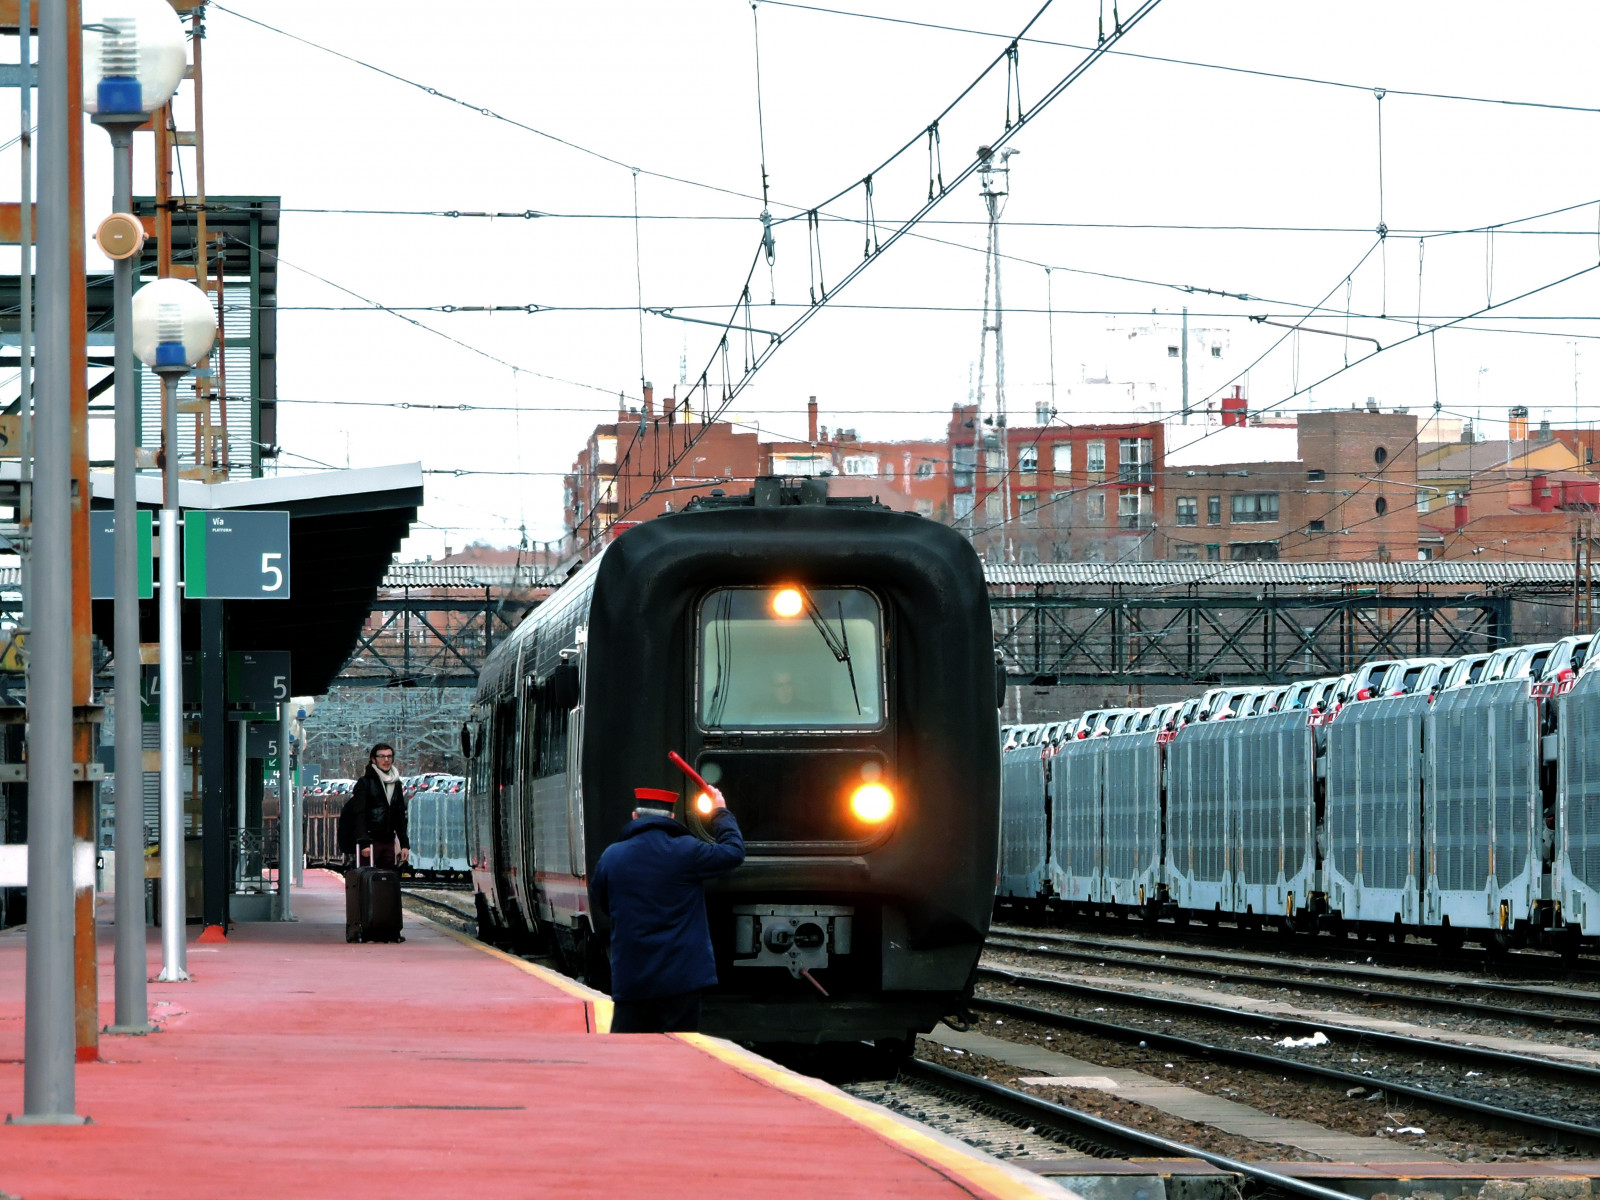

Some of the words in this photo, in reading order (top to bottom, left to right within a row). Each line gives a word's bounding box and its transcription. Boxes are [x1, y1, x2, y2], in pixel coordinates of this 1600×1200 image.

[261, 552, 283, 591] 5
[273, 675, 287, 699] 5
[268, 740, 278, 756] 5
[273, 770, 281, 779] 4
[313, 774, 320, 786] 5
